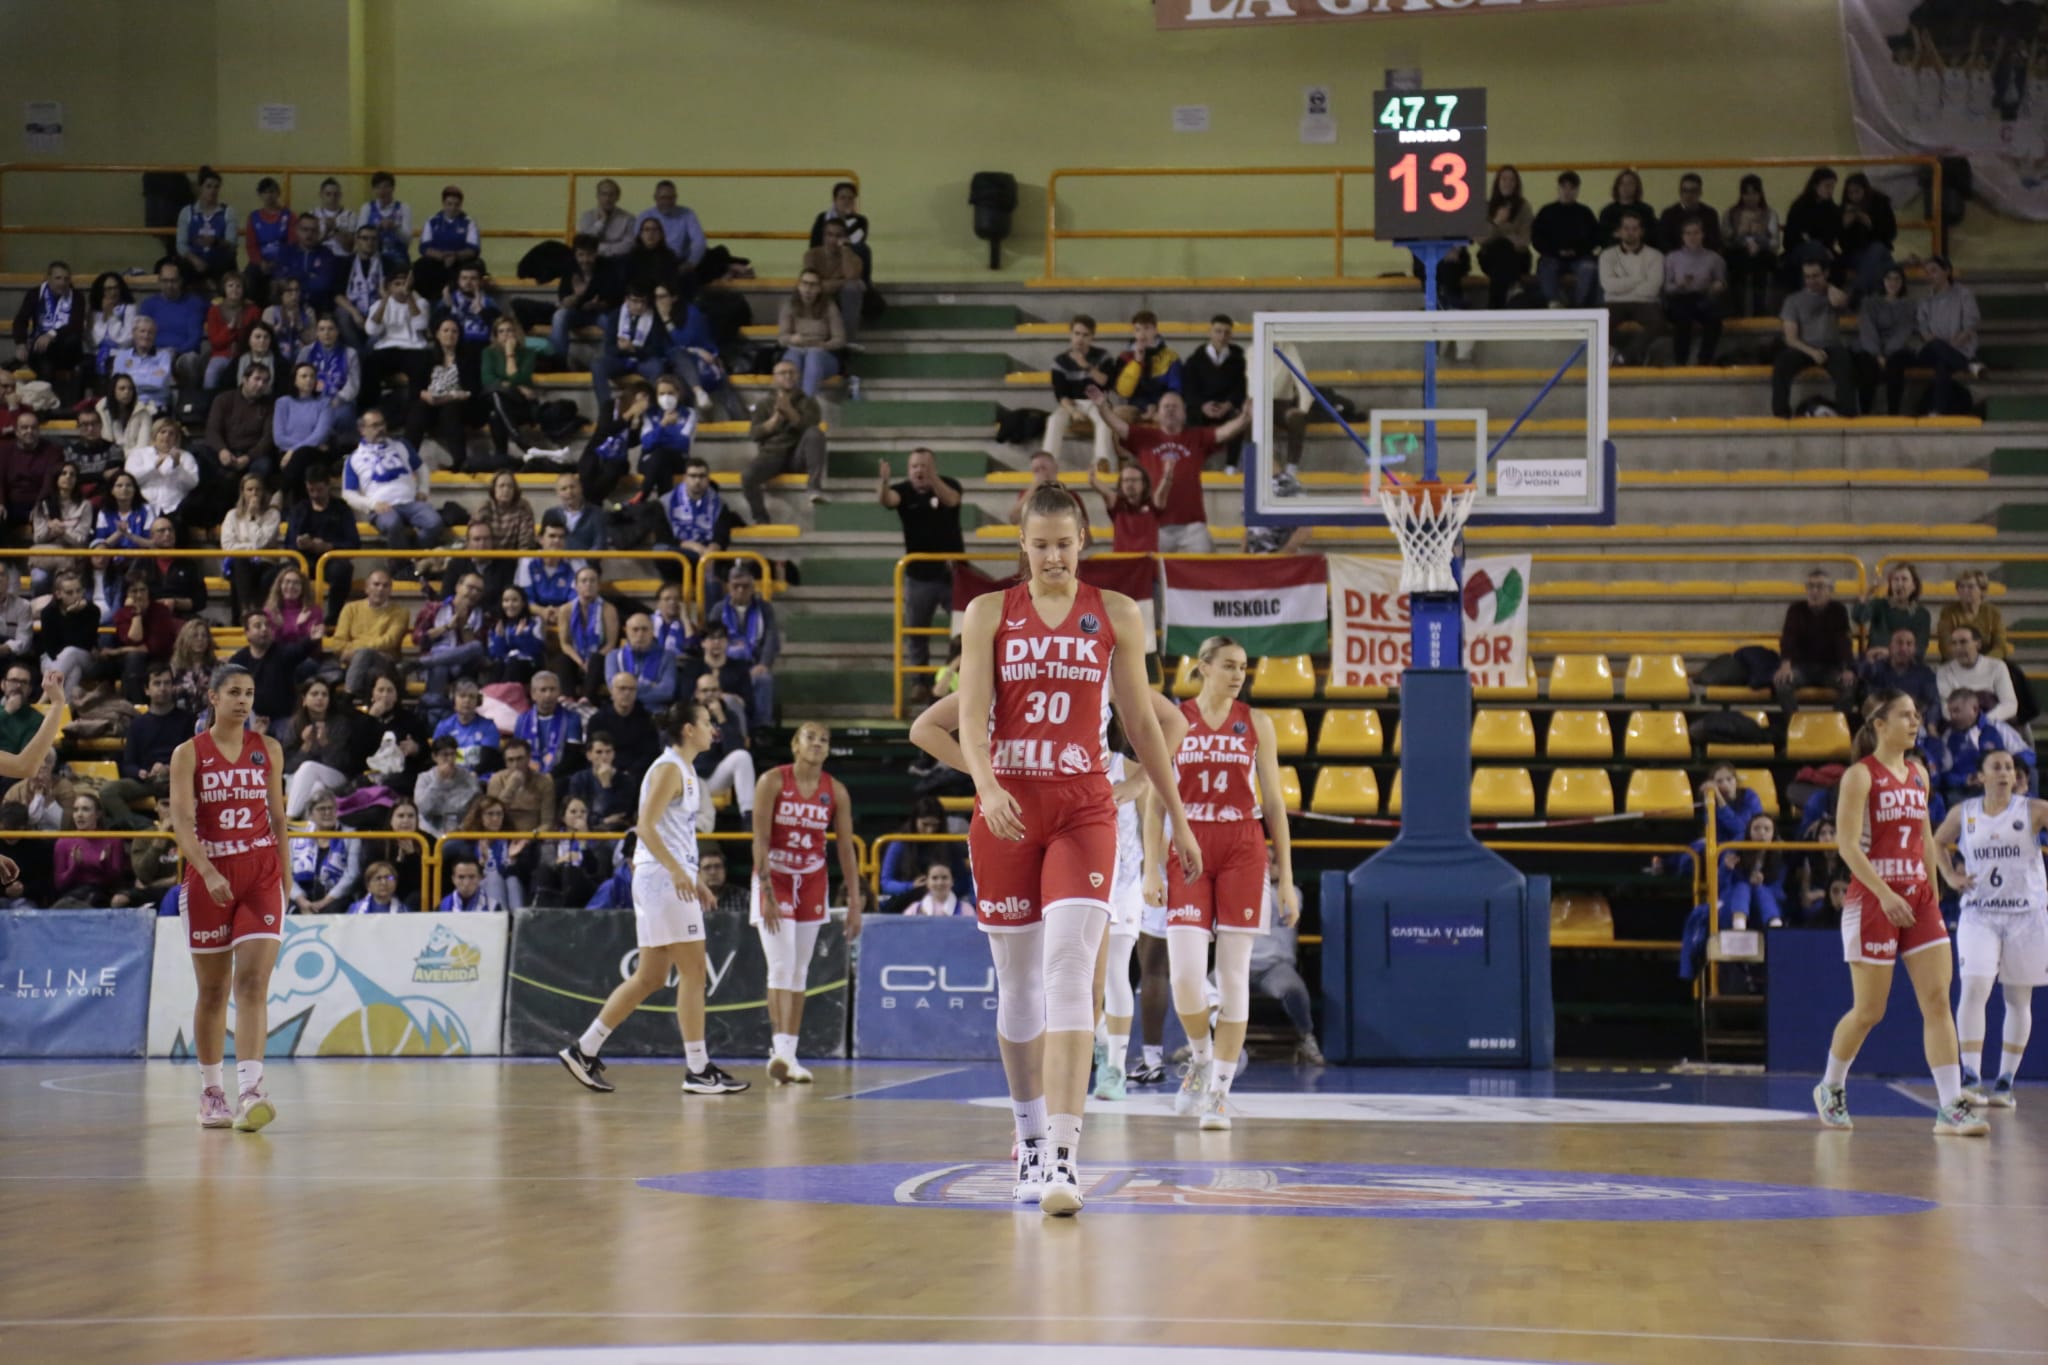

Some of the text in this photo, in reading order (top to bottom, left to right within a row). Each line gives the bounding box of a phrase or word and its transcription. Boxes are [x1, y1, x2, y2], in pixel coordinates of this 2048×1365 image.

[1379, 95, 1459, 130] 47.7
[1388, 152, 1470, 213] 13
[1523, 469, 1583, 478] EUROLEAGUE
[1524, 479, 1560, 487] WOMEN
[1213, 598, 1281, 617] MISKOLC
[1005, 636, 1099, 664] DVTK
[1429, 621, 1442, 668] MONDO
[1001, 661, 1102, 683] HUN-Therm
[1024, 690, 1071, 724] 30
[992, 739, 1056, 769] HELL
[1182, 735, 1248, 752] DVTK
[1177, 750, 1250, 766] HUN-Therm
[202, 768, 266, 790] DVTK
[1198, 769, 1229, 794] 14
[201, 787, 268, 803] HUN-Therm
[219, 807, 254, 830] 92
[780, 801, 830, 821] DVTK
[787, 831, 813, 849] 24
[1898, 825, 1912, 849] 7
[1989, 865, 2003, 888] 6
[979, 896, 1031, 918] apollo
[1391, 925, 1485, 939] CASTILLA Y LEÓN
[415, 967, 478, 981] AVENIDA
[17, 986, 116, 998] NEW YORK
[1468, 1037, 1516, 1049] MONDO
